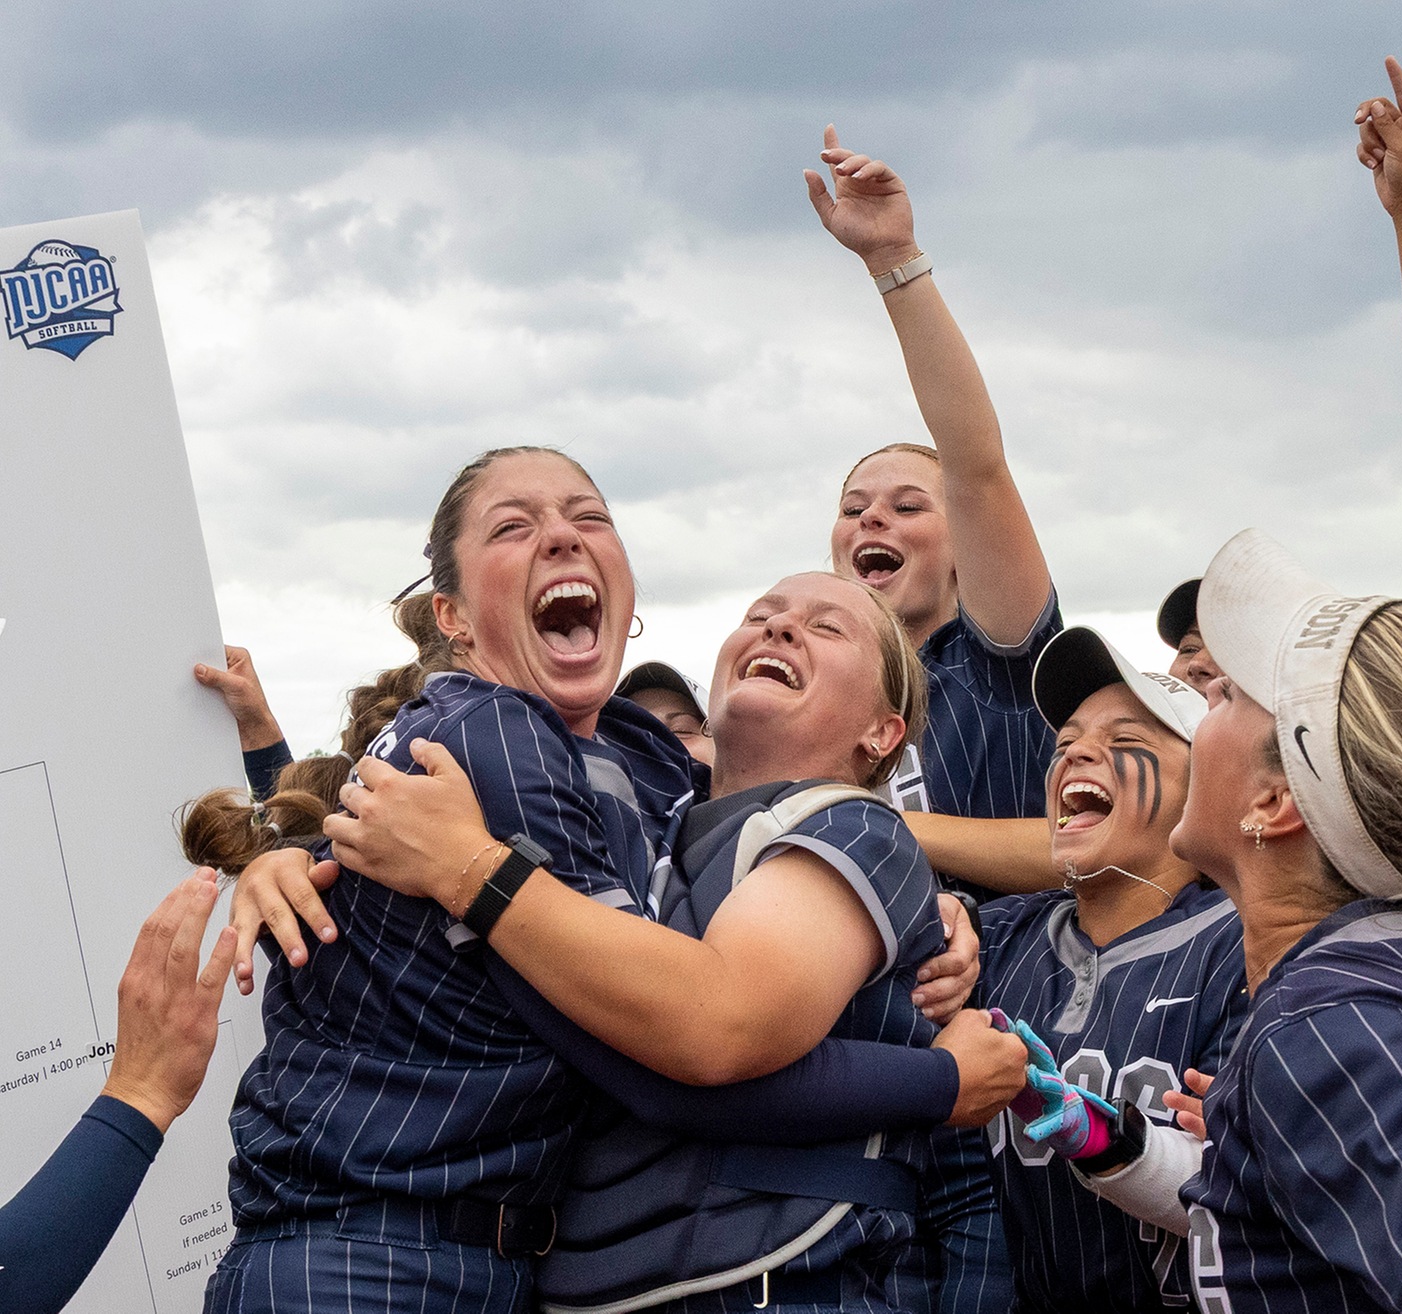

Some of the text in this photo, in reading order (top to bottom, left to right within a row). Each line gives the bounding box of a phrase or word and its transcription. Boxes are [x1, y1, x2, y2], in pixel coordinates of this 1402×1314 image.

[4, 263, 109, 330] NJCAA
[38, 321, 98, 339] SOFTBALL
[15, 1037, 63, 1063] Game 14
[0, 1071, 40, 1094] aturday
[50, 1057, 74, 1075] 4:00
[179, 1200, 223, 1226] Game 15
[182, 1221, 228, 1249] If needed
[165, 1259, 202, 1280] Sunday
